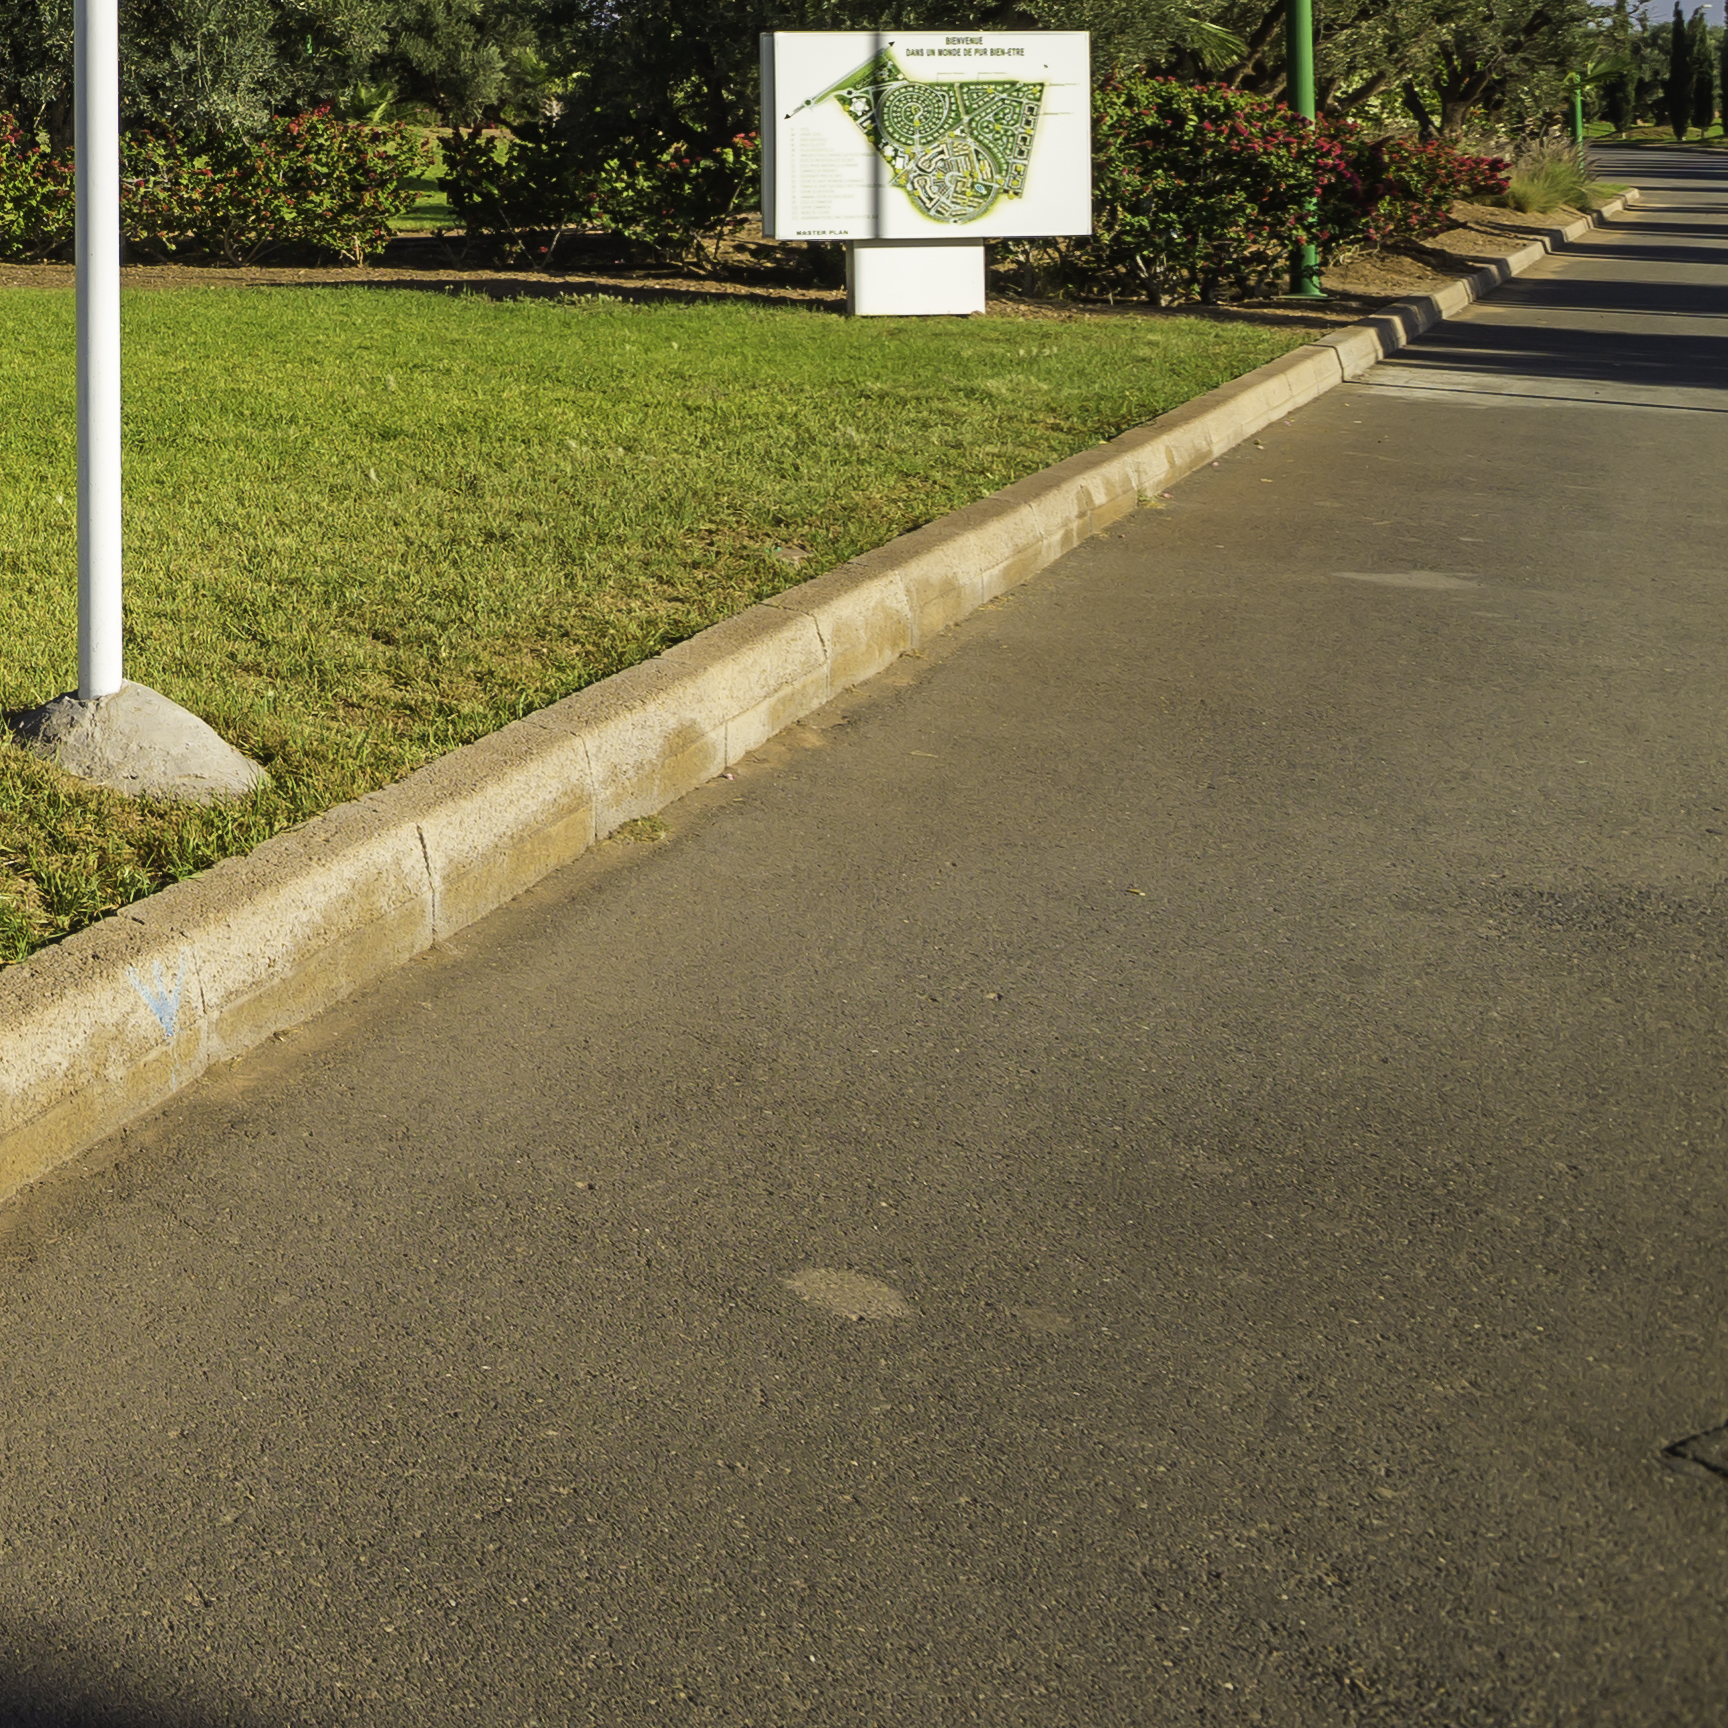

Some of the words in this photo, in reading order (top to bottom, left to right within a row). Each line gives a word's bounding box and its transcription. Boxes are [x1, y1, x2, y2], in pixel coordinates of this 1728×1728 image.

[945, 36, 983, 45] BIENVENUE
[905, 48, 924, 57] DANS
[926, 48, 935, 57] UN
[937, 48, 961, 57] MONDE
[963, 48, 972, 57] DE
[974, 48, 988, 57] PUR
